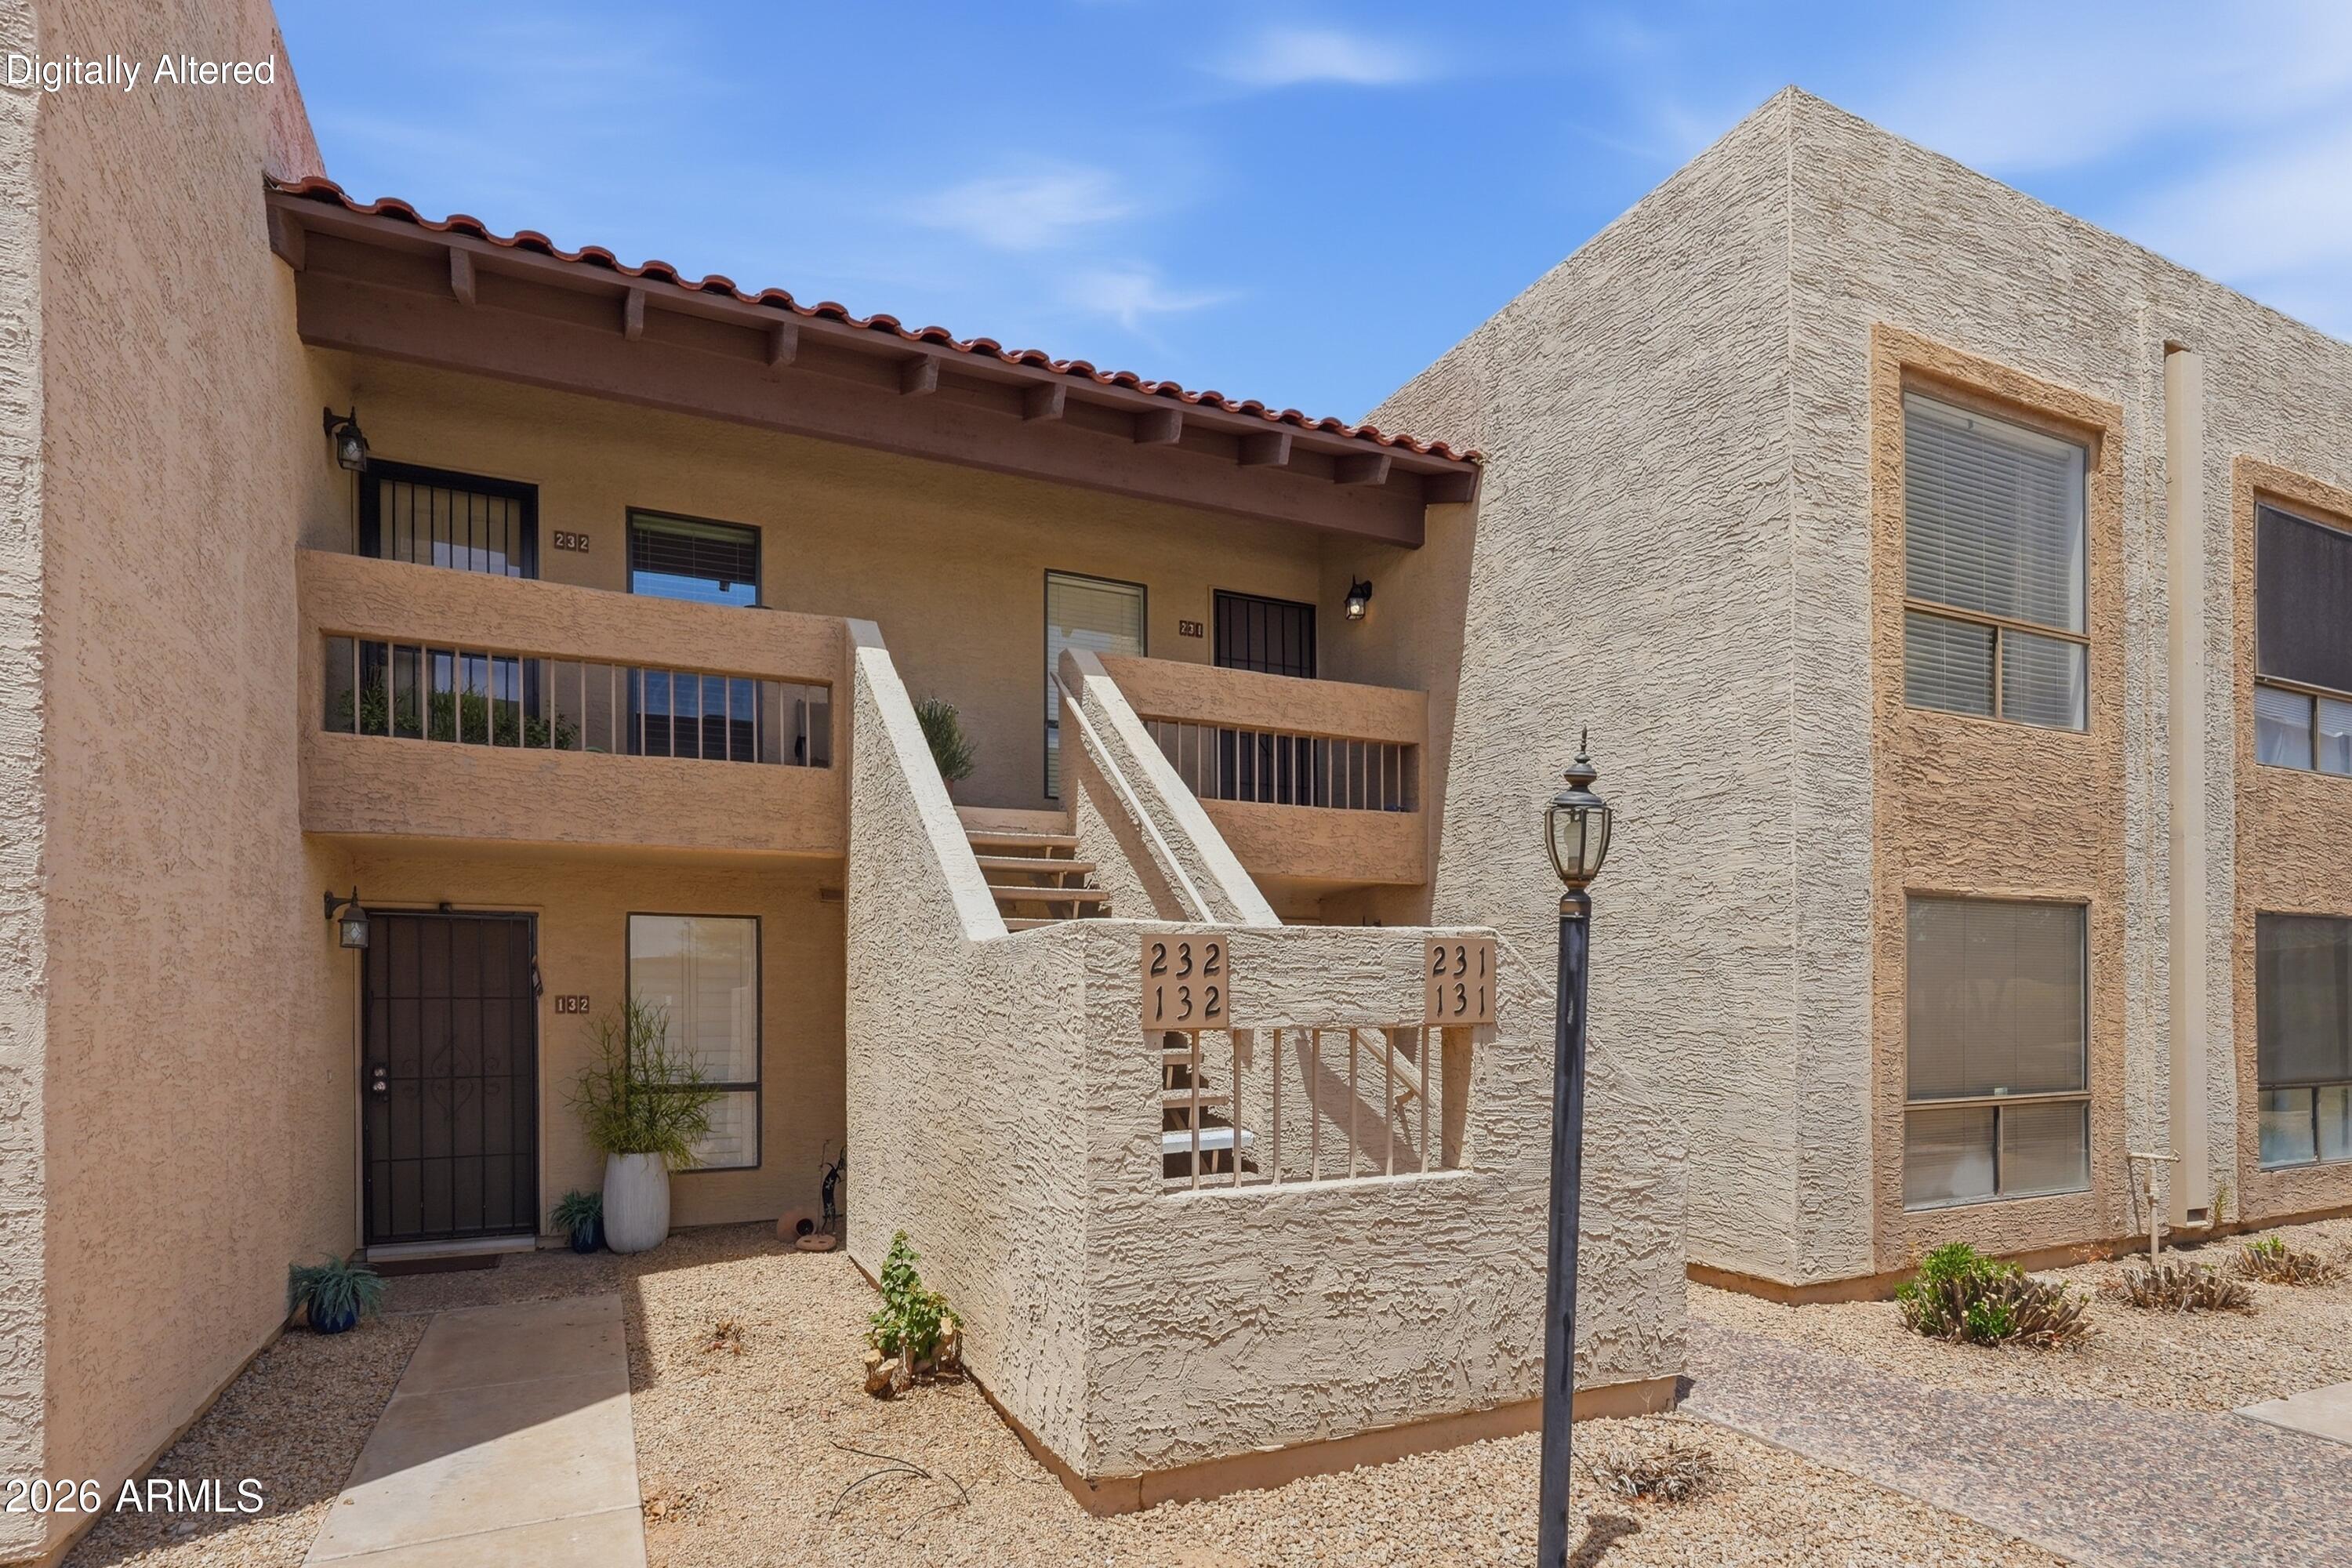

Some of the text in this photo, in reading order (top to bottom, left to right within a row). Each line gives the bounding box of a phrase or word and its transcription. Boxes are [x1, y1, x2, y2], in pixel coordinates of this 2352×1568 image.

[556, 533, 588, 550] 232
[1181, 622, 1201, 635] 231
[1150, 942, 1221, 979] 232
[1432, 945, 1486, 978] 231
[557, 998, 588, 1011] 132
[1155, 984, 1221, 1020] 132
[1436, 982, 1486, 1018] 131
